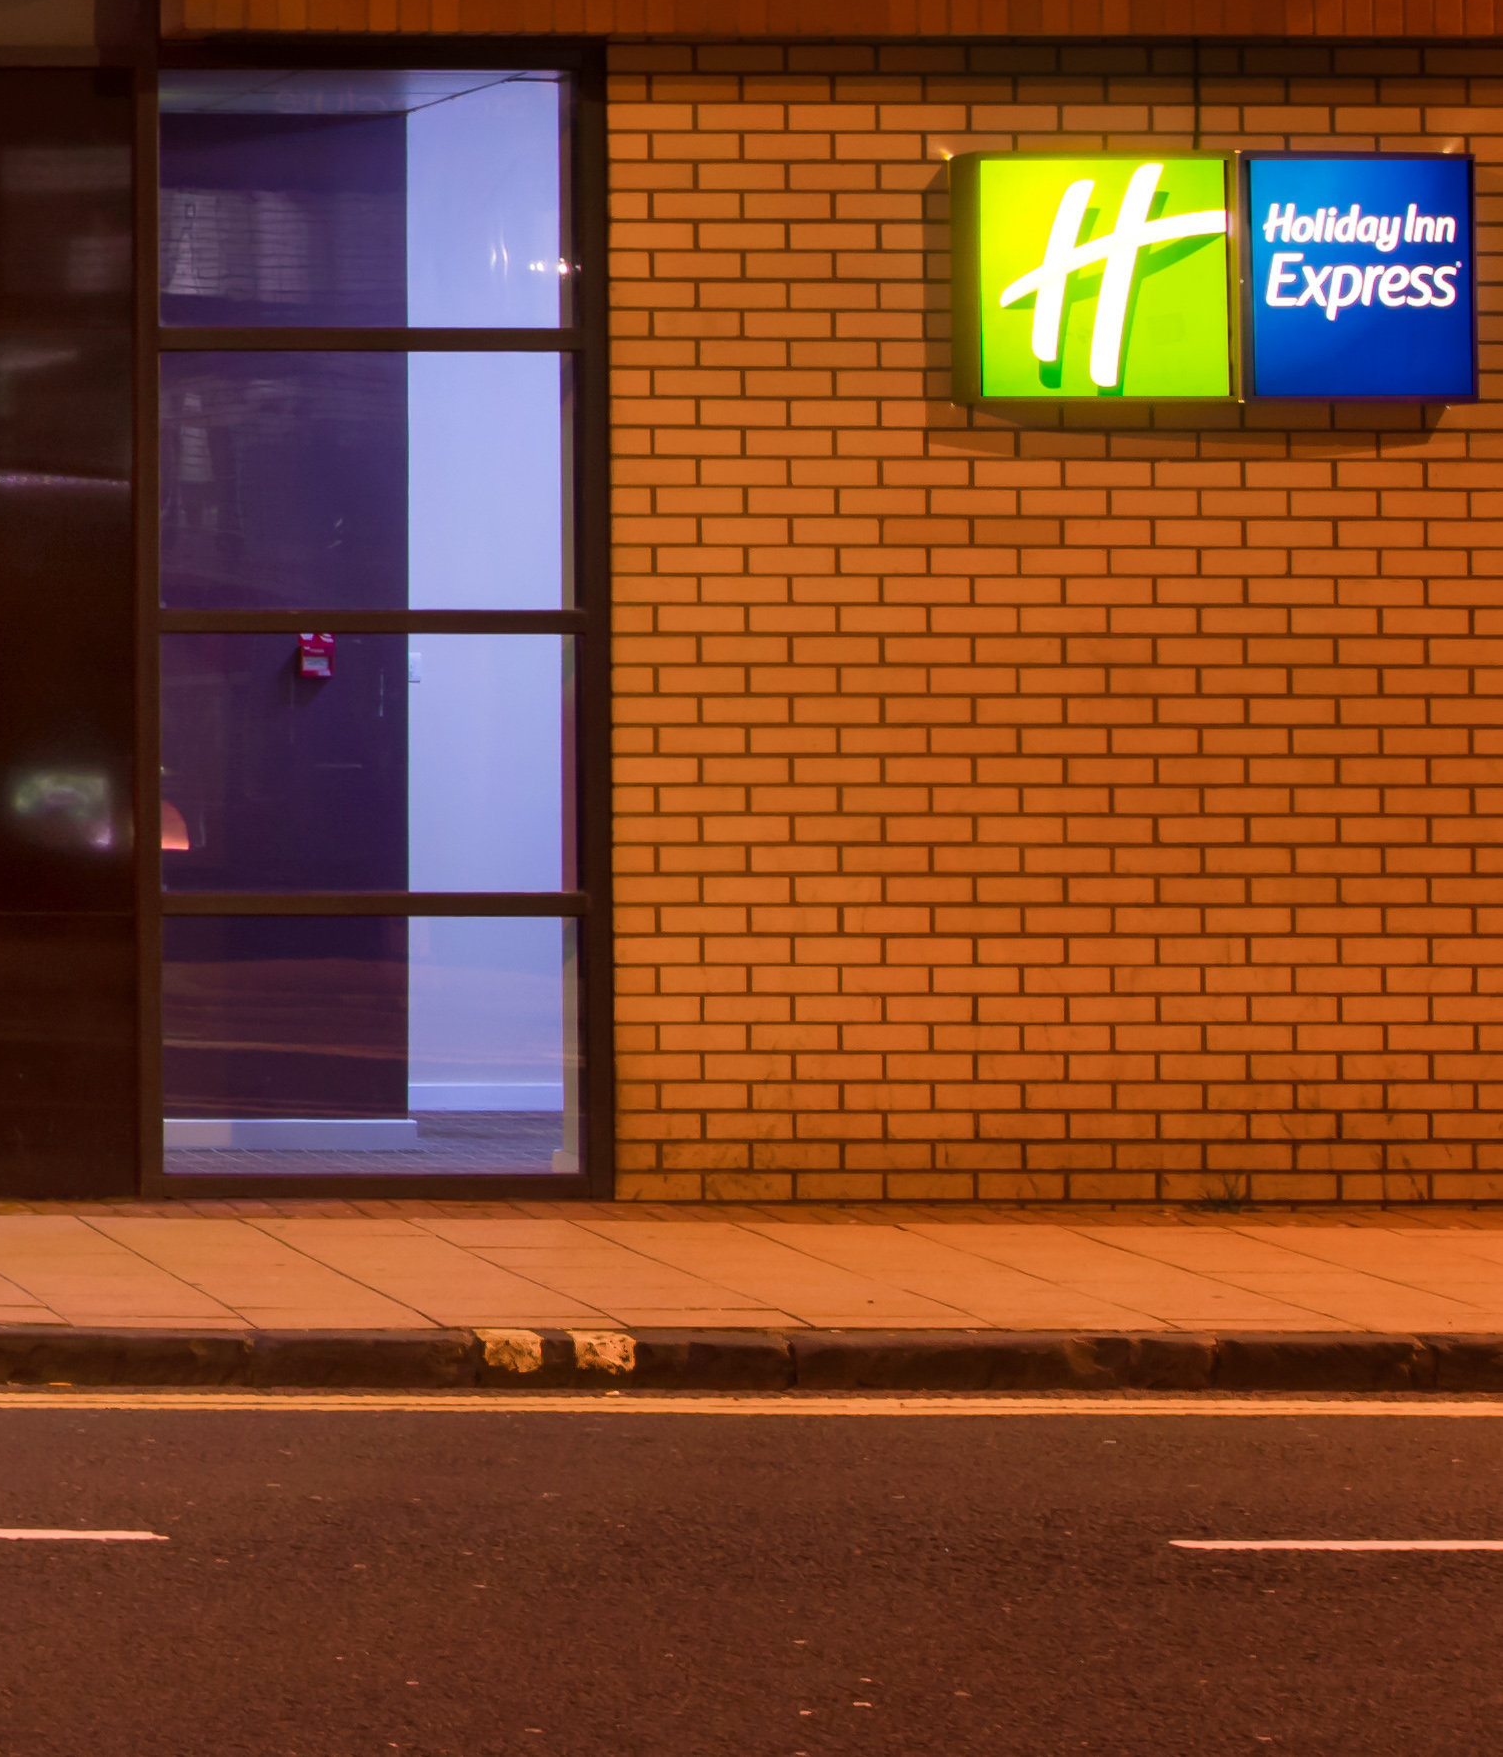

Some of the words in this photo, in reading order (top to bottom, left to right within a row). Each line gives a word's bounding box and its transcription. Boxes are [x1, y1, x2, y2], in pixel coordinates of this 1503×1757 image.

[1262, 202, 1402, 253] Holiday
[1404, 203, 1457, 243] Inn
[1265, 252, 1458, 322] Express
